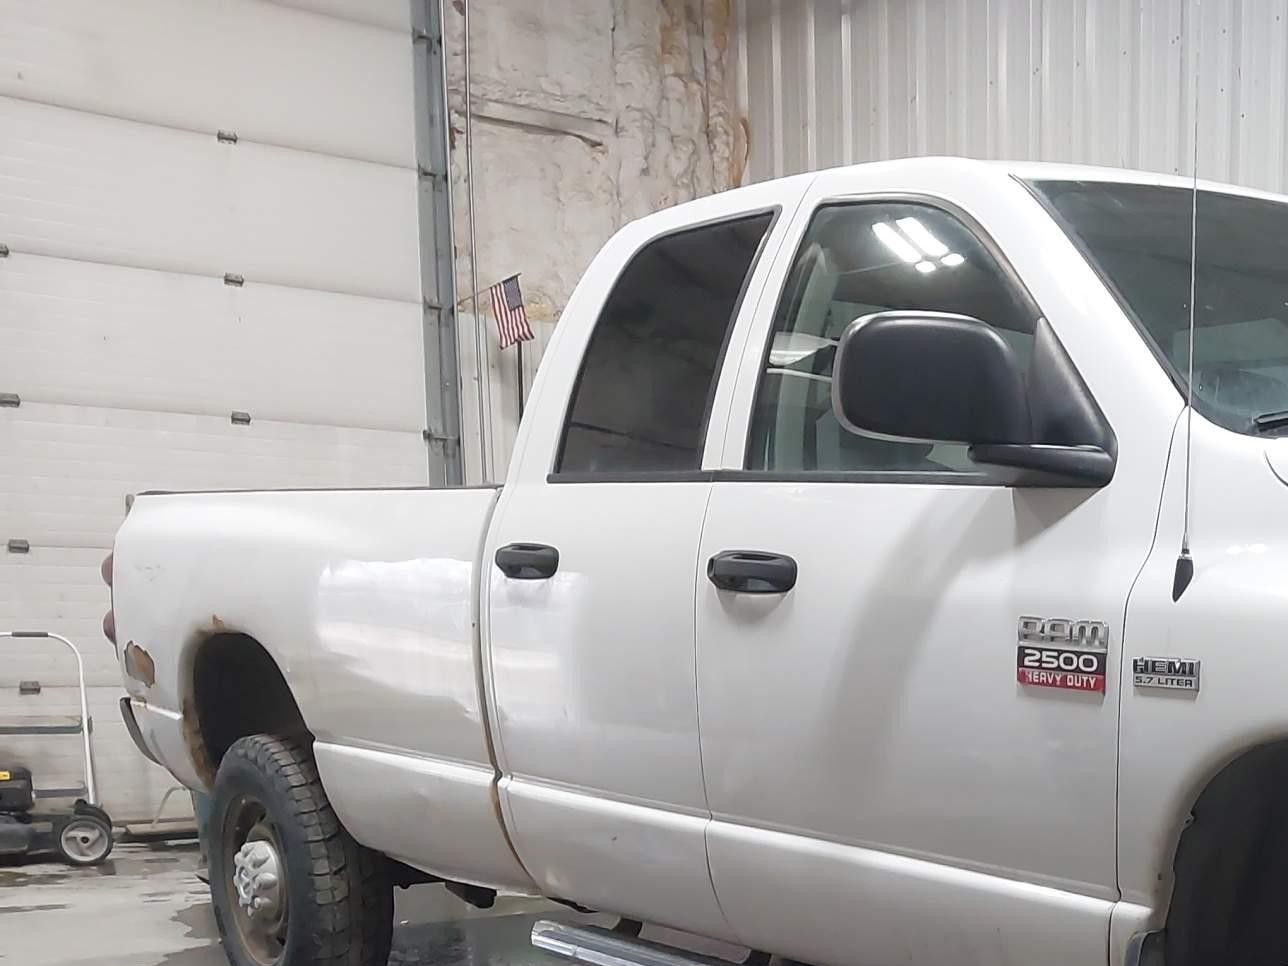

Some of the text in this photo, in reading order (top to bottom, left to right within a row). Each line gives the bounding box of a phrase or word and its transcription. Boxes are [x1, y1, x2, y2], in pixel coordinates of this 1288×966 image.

[1018, 616, 1109, 649] RAM
[1023, 649, 1098, 673] 2500
[1133, 657, 1197, 676] HEMI
[1066, 674, 1097, 690] DUTY
[1135, 675, 1193, 688] 5.7 LITER
